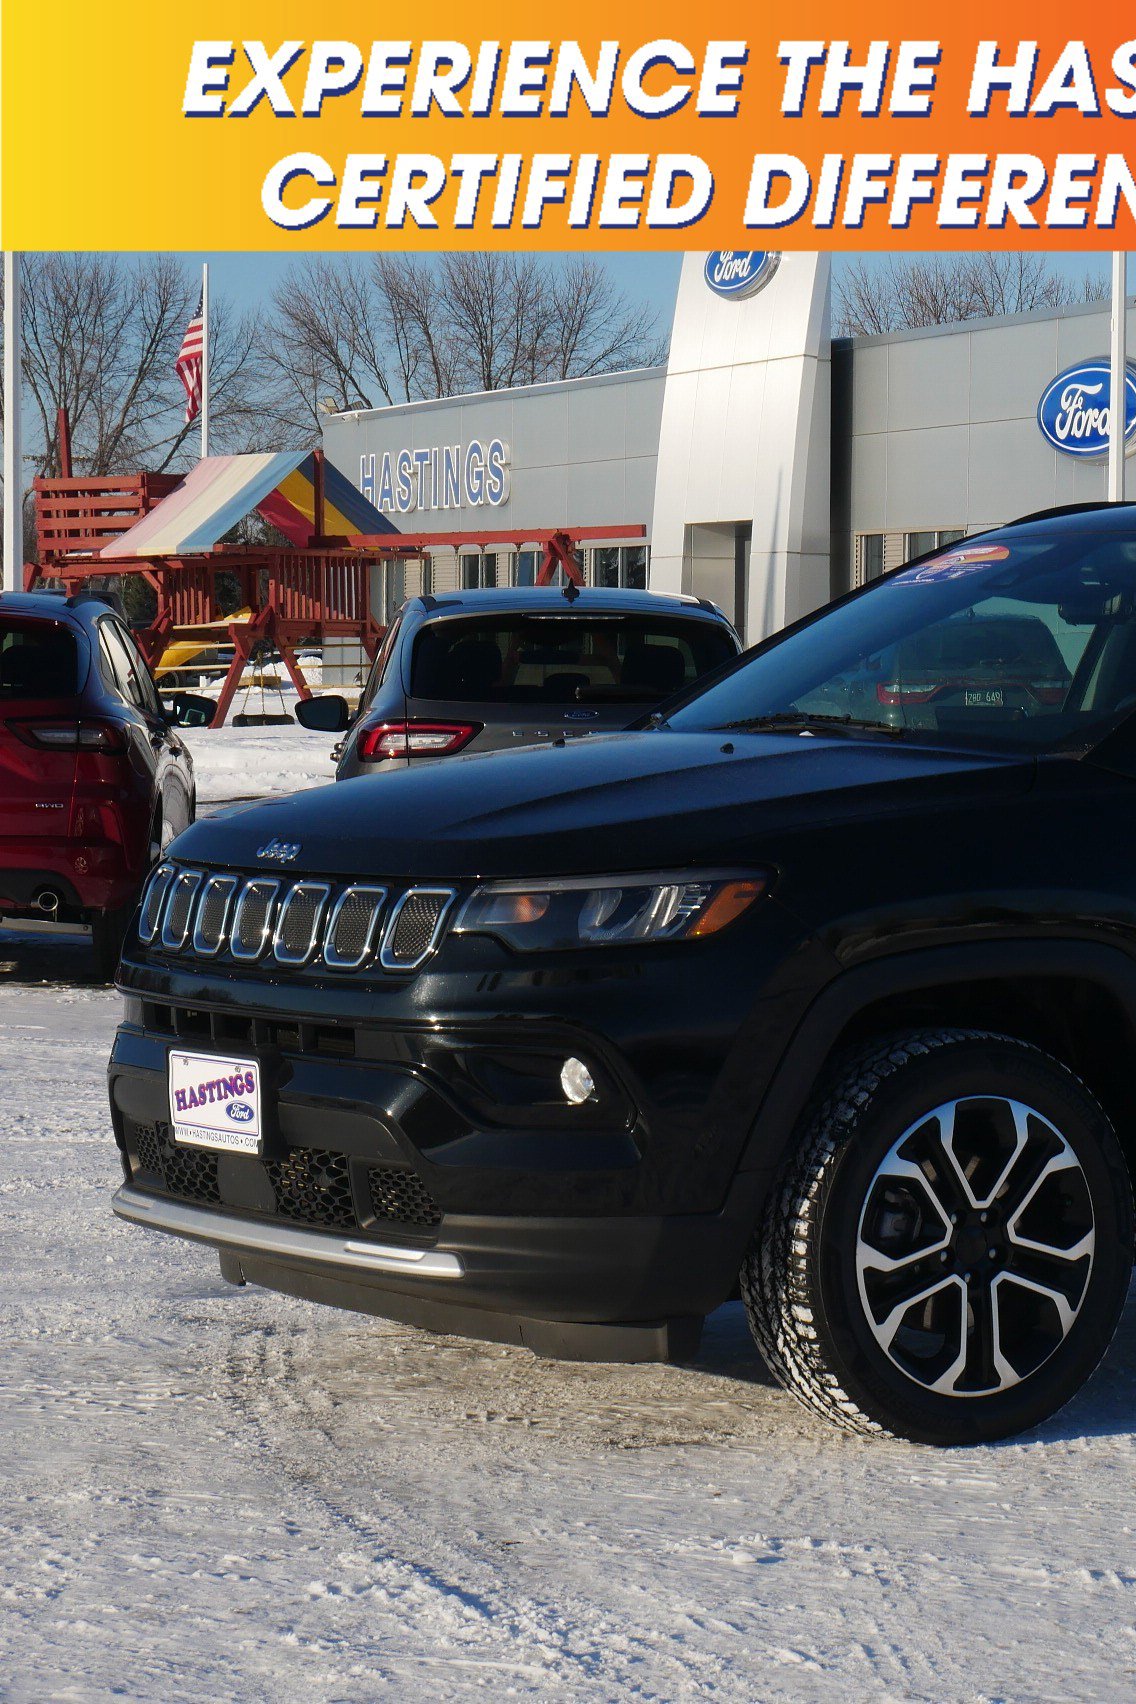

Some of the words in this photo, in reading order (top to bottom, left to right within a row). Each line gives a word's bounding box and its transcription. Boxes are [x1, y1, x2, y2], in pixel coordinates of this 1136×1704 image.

[360, 438, 509, 513] HASTINGS
[256, 837, 302, 863] Jeep
[175, 1071, 255, 1111] HASTINGS
[230, 1103, 250, 1120] Ford
